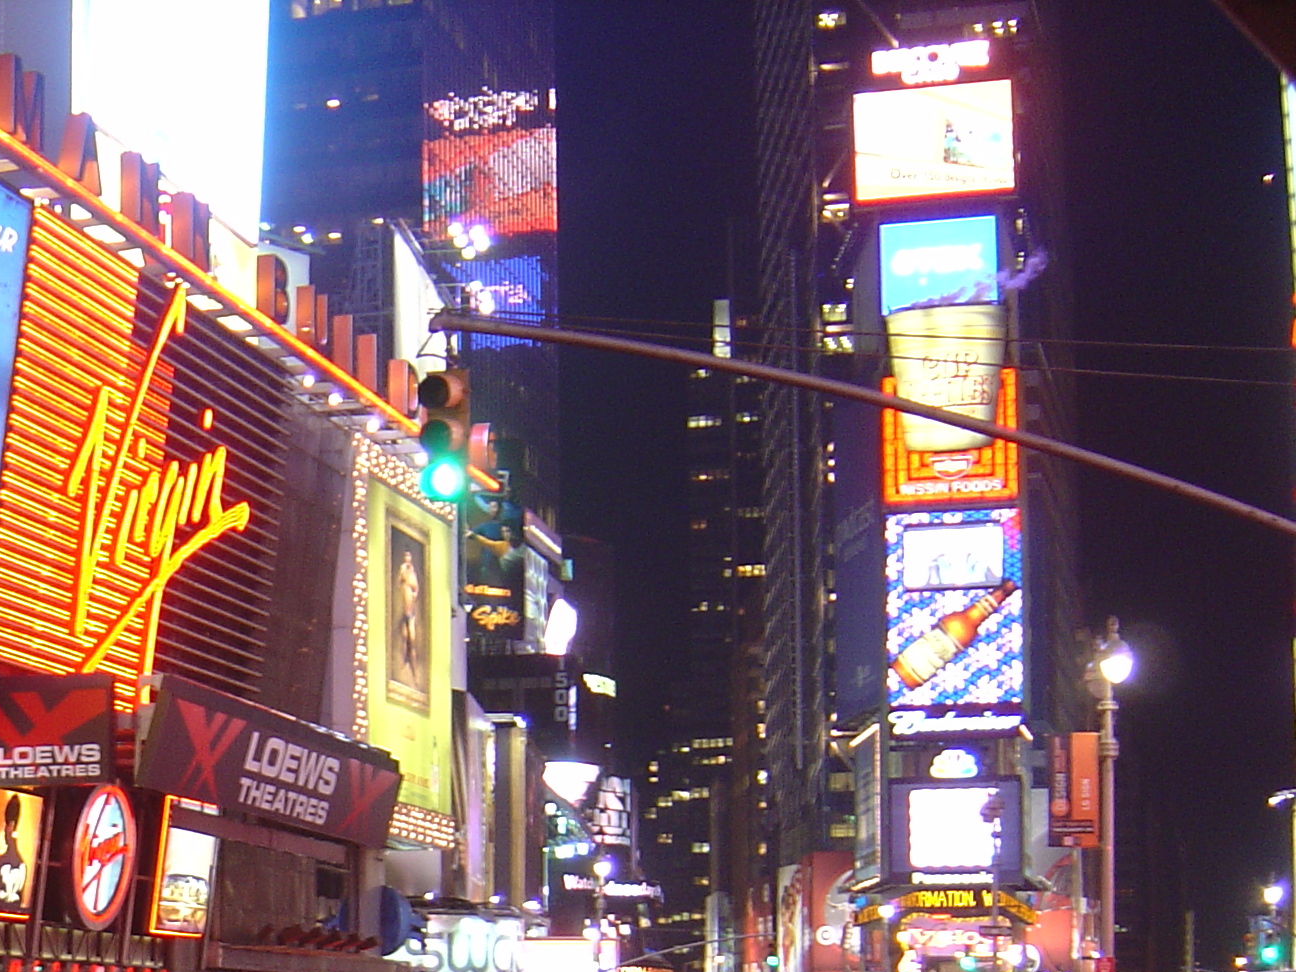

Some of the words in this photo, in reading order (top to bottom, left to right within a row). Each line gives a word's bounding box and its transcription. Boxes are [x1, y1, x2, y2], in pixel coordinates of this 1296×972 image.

[66, 283, 250, 690] Virgin
[900, 481, 950, 496] NISSIN
[951, 479, 1002, 493] FOODS
[887, 710, 1022, 735] Budweiser
[243, 731, 340, 795] LOEWS
[237, 777, 330, 825] THEATRES
